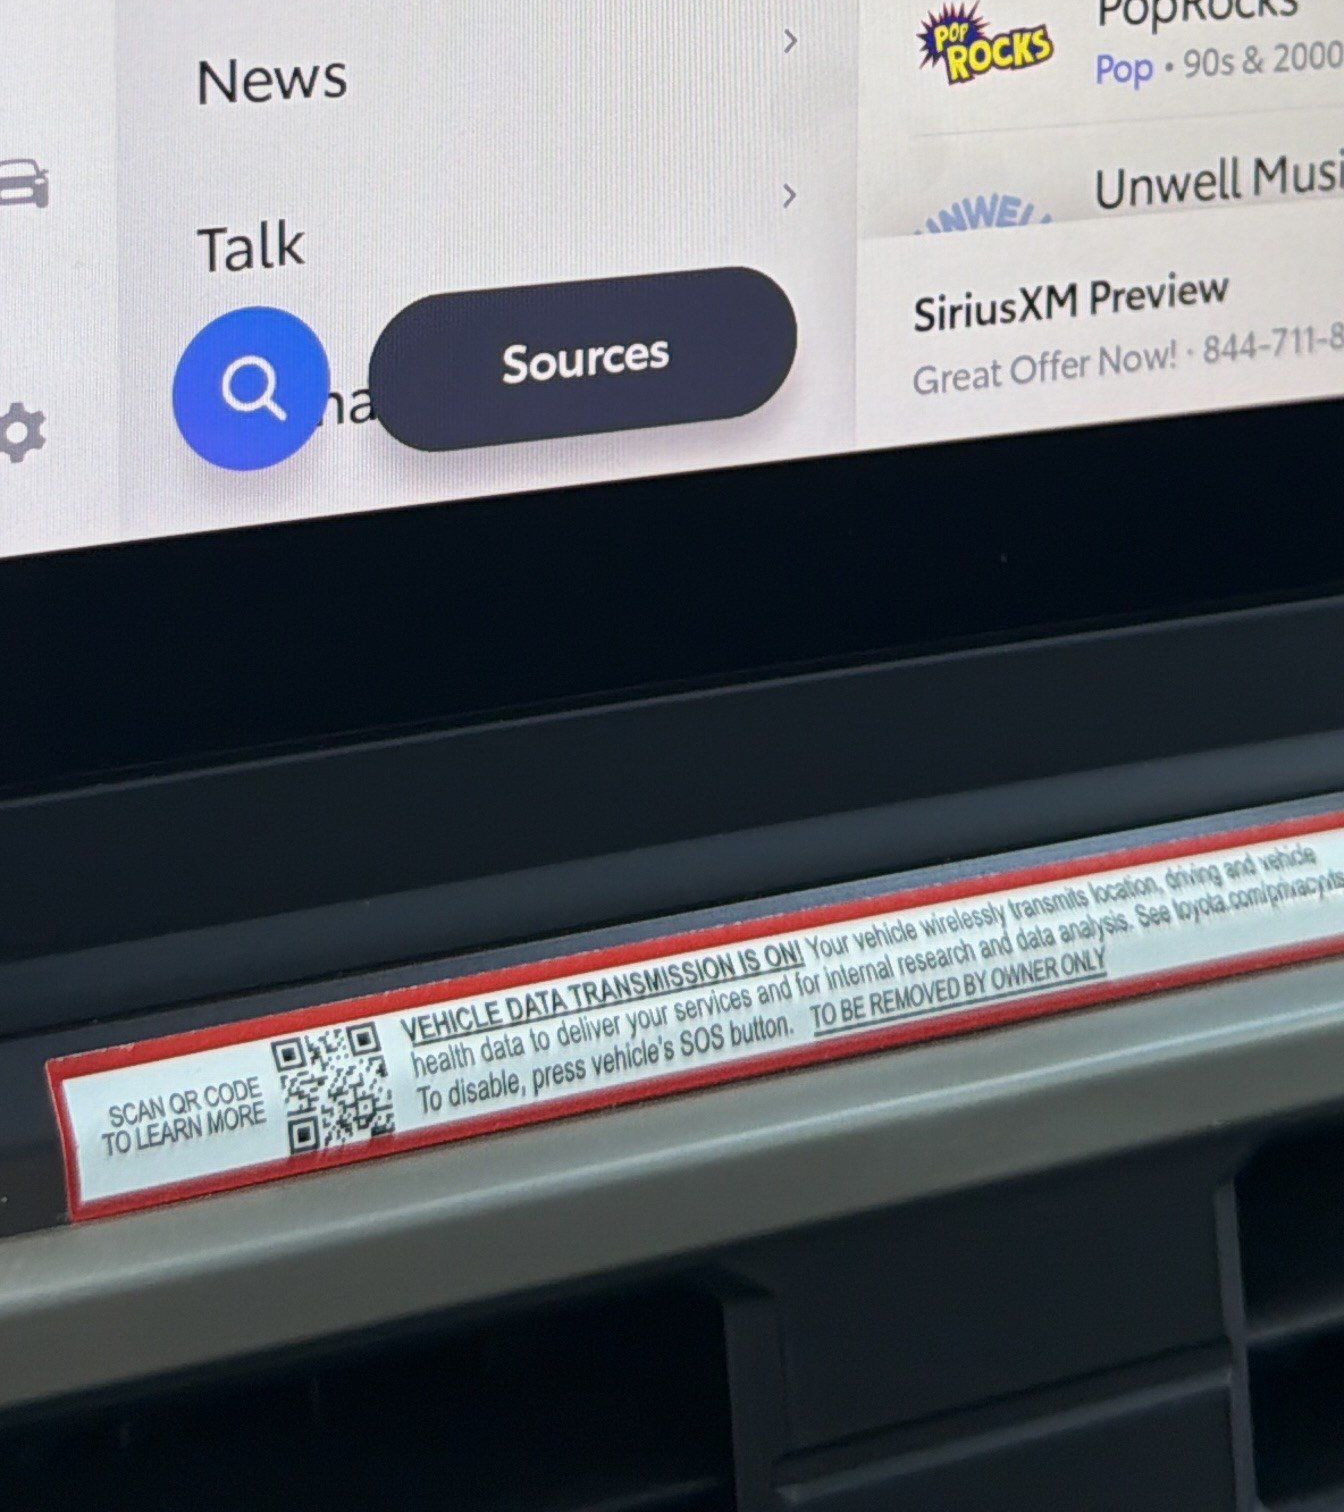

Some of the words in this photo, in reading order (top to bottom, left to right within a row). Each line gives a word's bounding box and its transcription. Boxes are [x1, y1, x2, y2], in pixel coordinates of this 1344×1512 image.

[934, 22, 970, 52] POP
[946, 28, 1052, 81] ROCKS
[197, 59, 348, 105] News
[1096, 53, 1154, 90] Pop
[1184, 47, 1235, 81] 90s
[1243, 45, 1264, 75] &
[1096, 158, 1242, 211] Unwell
[197, 220, 305, 274] Talk
[913, 282, 1079, 333] SiriusXM
[1089, 270, 1230, 316] Preview
[502, 335, 670, 385] Sources
[912, 361, 1003, 397] Great
[1009, 349, 1090, 386] Offer
[1098, 340, 1178, 378] Now!
[400, 1000, 503, 1042] VEHICLE
[506, 989, 568, 1021] DATA
[567, 952, 734, 1007] TRANSMISSION
[737, 949, 761, 973] IS
[764, 939, 804, 968] ON!
[805, 935, 849, 960] Your
[851, 919, 918, 951] vehicle
[920, 901, 1006, 938] wirelessly
[1008, 886, 1089, 920] transmits
[1088, 875, 1164, 904] location,
[1165, 863, 1223, 890] driving
[1223, 851, 1256, 879] and
[1258, 843, 1318, 872] vehicle
[410, 1042, 476, 1078] health
[481, 1036, 525, 1063] data
[529, 1027, 550, 1052] to
[557, 1014, 621, 1047] deliver
[627, 1006, 668, 1039] your
[673, 988, 753, 1023] services
[757, 975, 793, 1005] and
[795, 971, 820, 997] for
[825, 953, 895, 991] internal
[897, 939, 976, 976] research
[979, 931, 1013, 958] and
[1016, 923, 1056, 951] data
[1058, 909, 1134, 943] analysis.
[1134, 903, 1171, 928] See
[416, 1086, 442, 1113] To
[449, 1069, 526, 1107] disable,
[532, 1058, 587, 1096] press
[591, 1038, 675, 1076] vehicle's
[680, 1023, 725, 1057] SOS
[729, 1013, 794, 1047] button.
[809, 1003, 837, 1028] TO
[840, 995, 865, 1022] BE
[869, 976, 960, 1016] REMOVED
[963, 969, 986, 996] BY
[991, 956, 1058, 987] OWNER
[1061, 946, 1106, 976] ONLY
[102, 1130, 131, 1156] TO
[135, 1114, 203, 1150] LEARN
[207, 1100, 267, 1136] MORE
[109, 1095, 166, 1128] SCAN
[169, 1090, 202, 1114] QR
[204, 1076, 263, 1107] CODE
